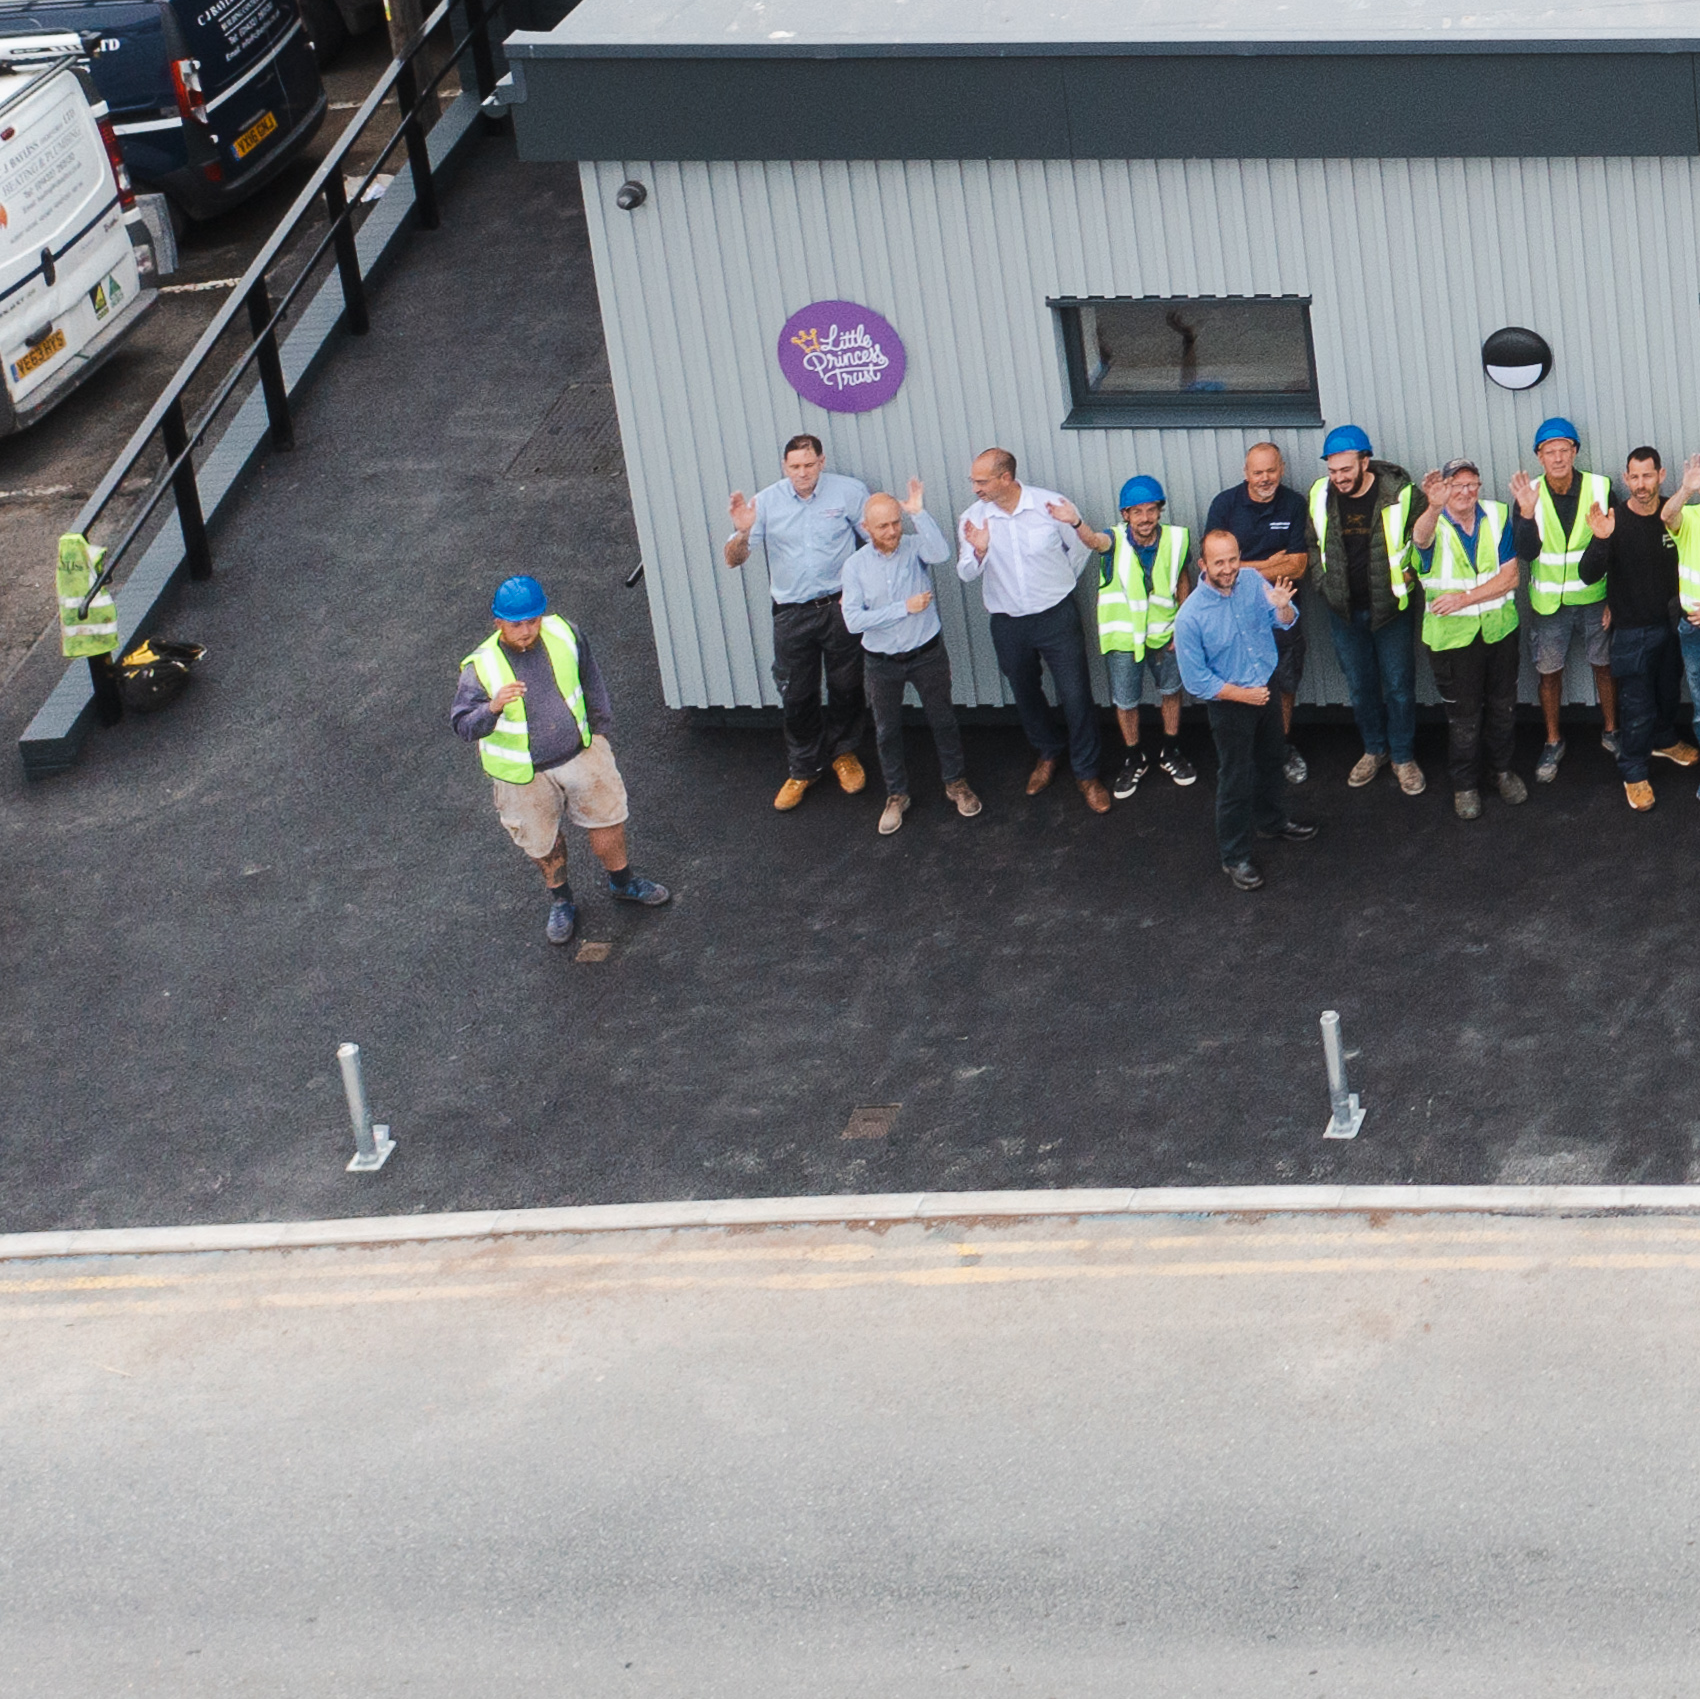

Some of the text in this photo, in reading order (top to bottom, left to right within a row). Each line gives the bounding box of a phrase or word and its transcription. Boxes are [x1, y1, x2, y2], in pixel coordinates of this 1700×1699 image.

[2, 164, 40, 197] HEATING
[820, 324, 872, 351] Little
[16, 345, 44, 374] VE63
[803, 344, 889, 378] Princess
[823, 364, 880, 390] Trust
